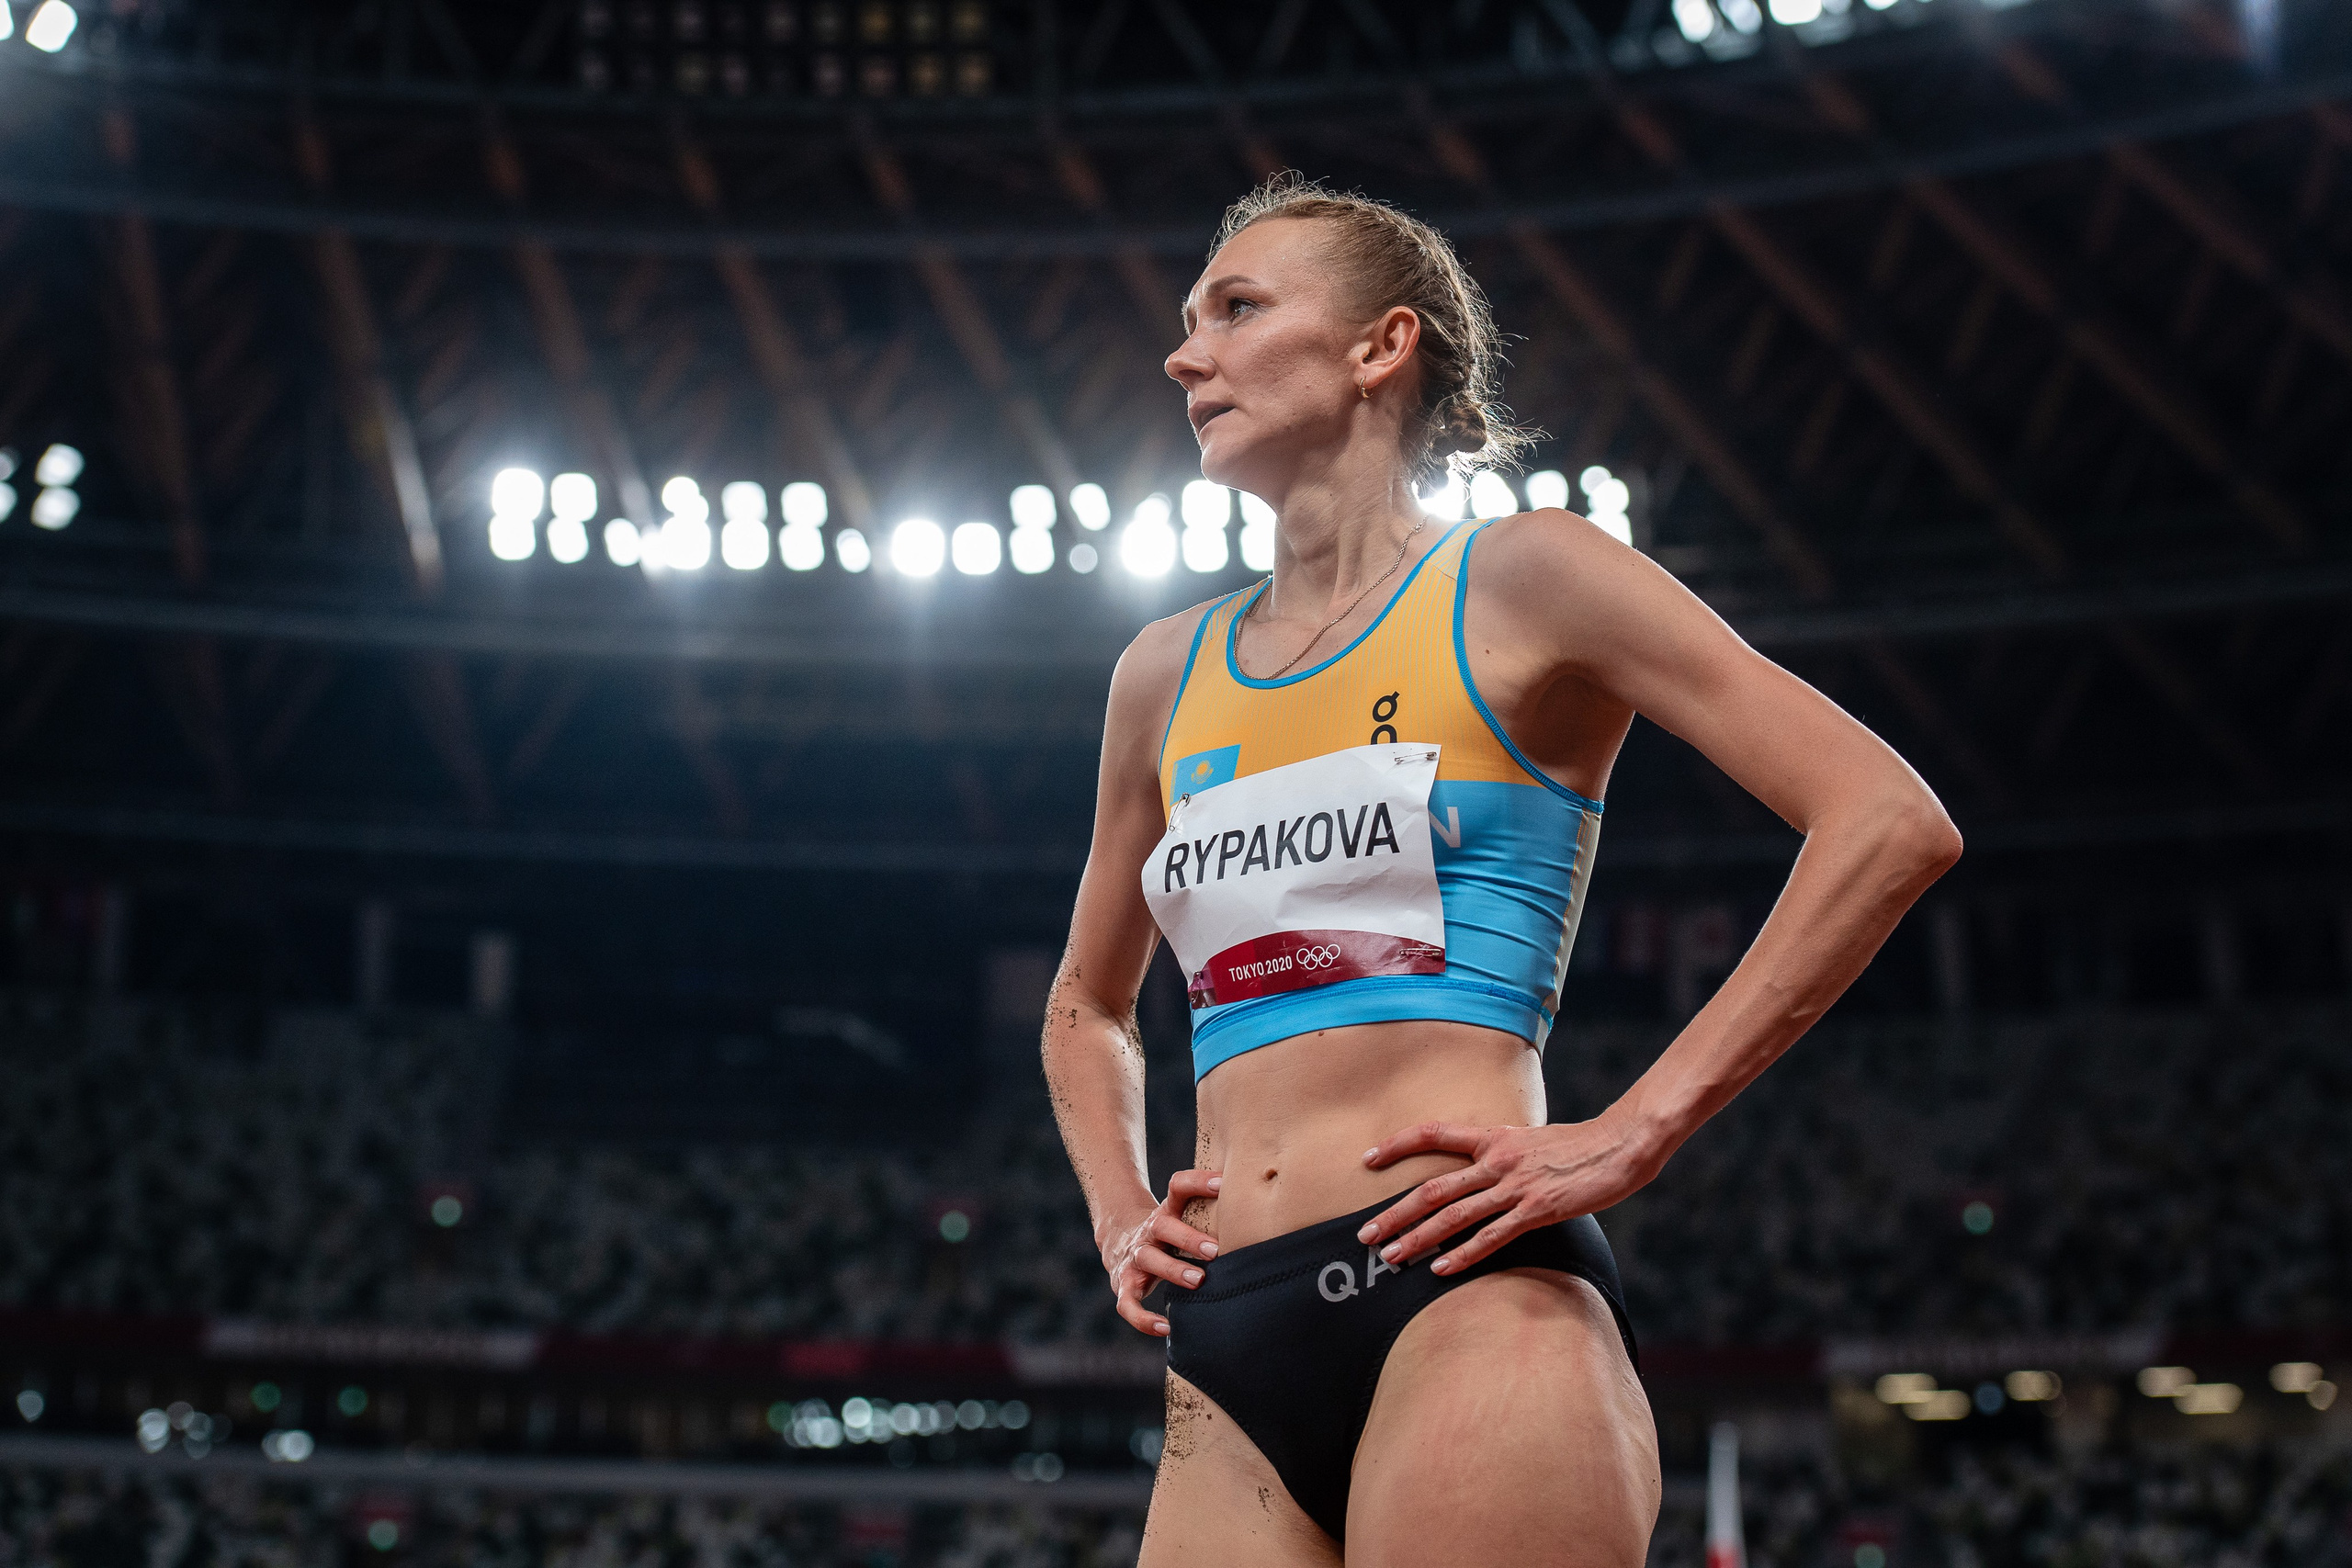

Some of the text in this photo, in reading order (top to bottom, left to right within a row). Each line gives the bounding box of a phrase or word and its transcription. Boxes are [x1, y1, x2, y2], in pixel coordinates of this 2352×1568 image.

[1164, 802, 1400, 894] RYPAKOVA
[1228, 955, 1293, 982] TOKYO 2020
